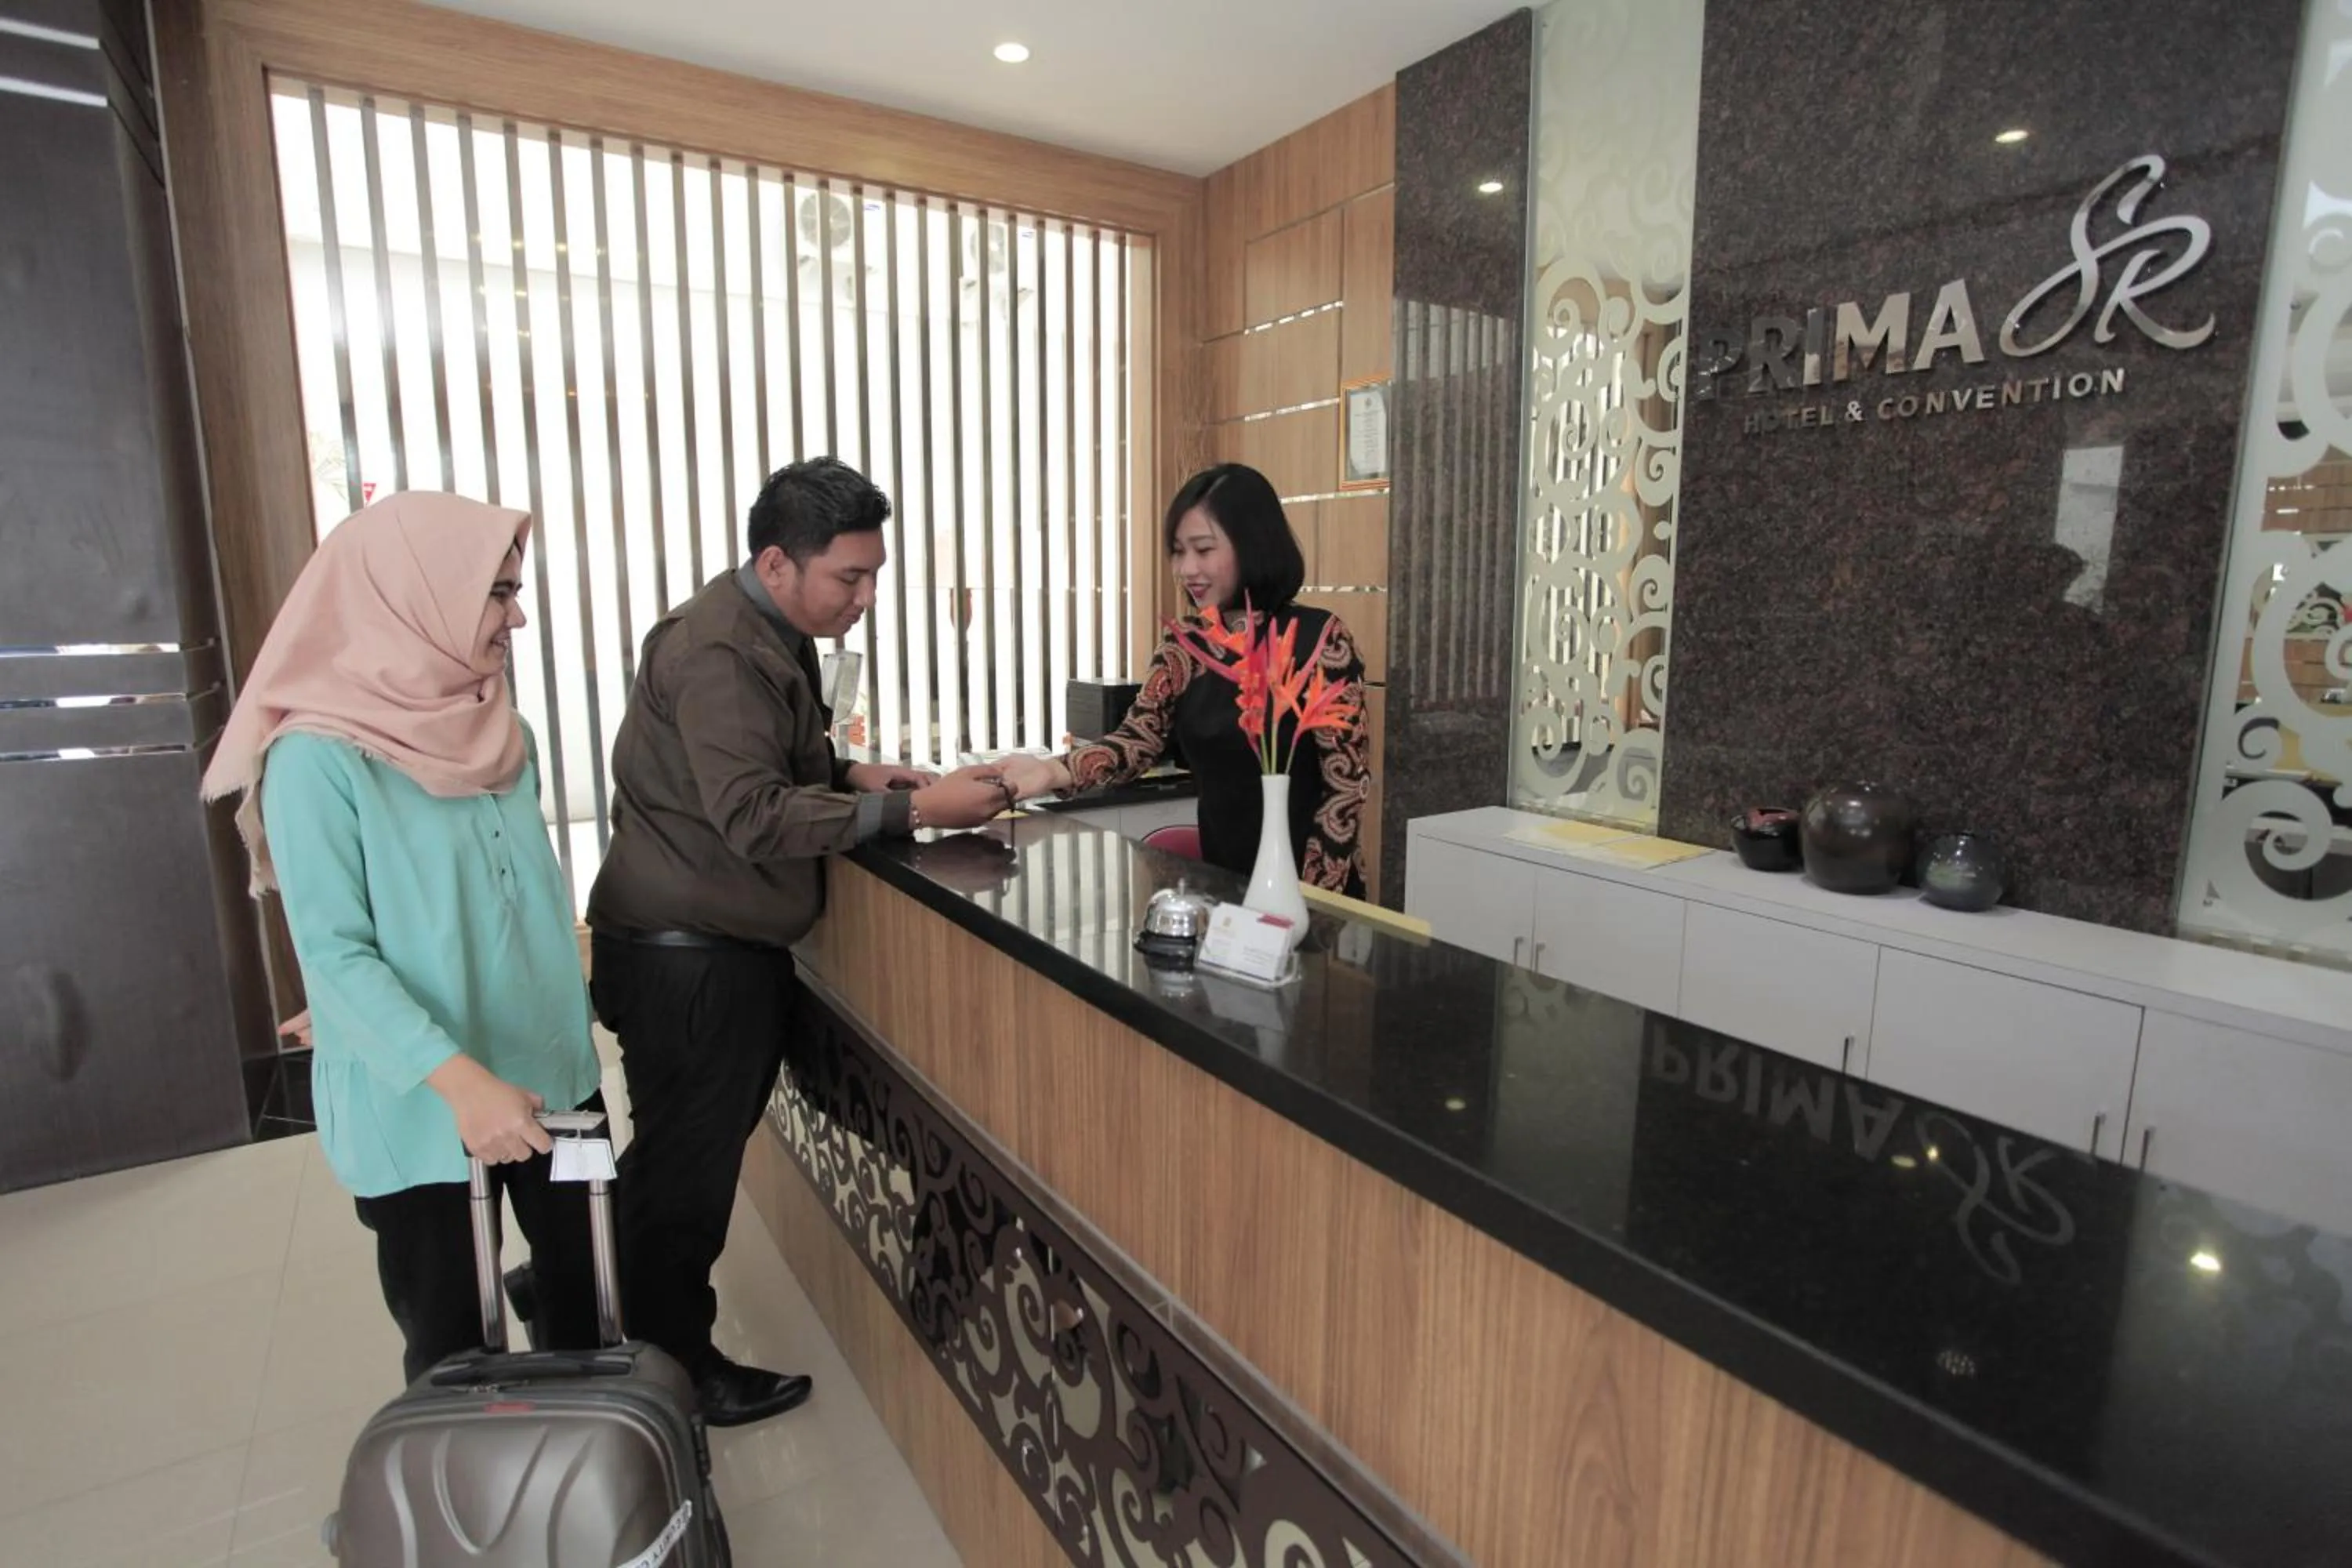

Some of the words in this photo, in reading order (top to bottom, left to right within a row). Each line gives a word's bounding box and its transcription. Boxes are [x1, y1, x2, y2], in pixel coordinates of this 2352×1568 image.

[1697, 278, 1986, 401] PRIMA
[1744, 405, 1835, 434] HOTEL
[1845, 400, 1867, 423] &
[1877, 368, 2125, 421] CONVENTION
